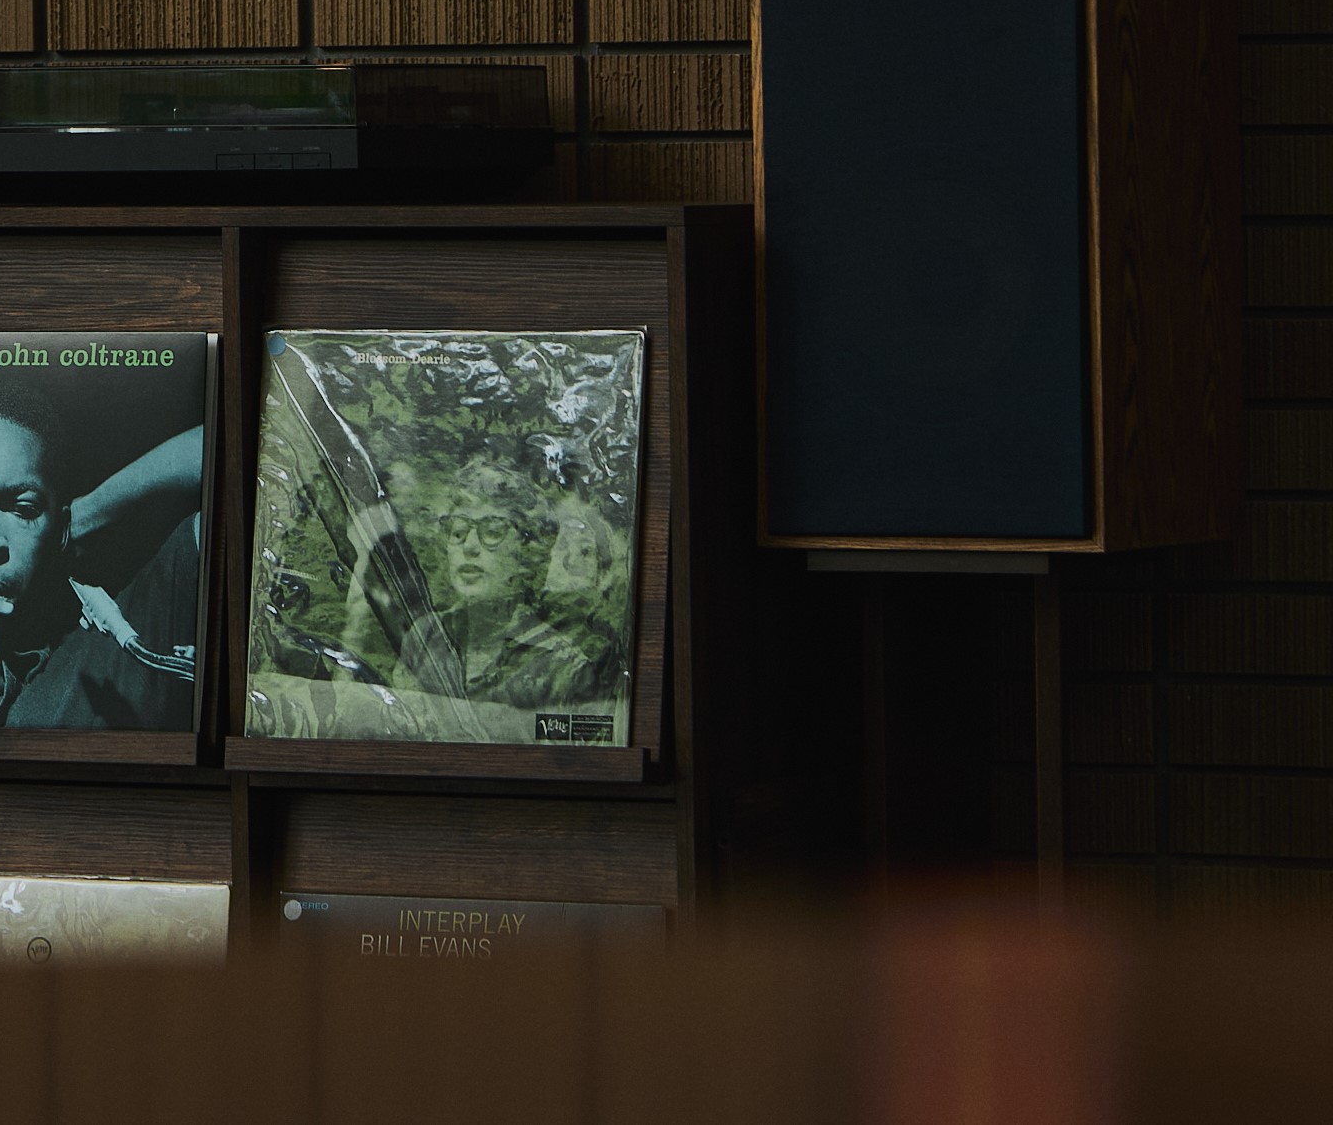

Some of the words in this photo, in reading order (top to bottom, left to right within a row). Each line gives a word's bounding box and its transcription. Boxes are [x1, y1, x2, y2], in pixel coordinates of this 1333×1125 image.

[59, 343, 174, 367] coltrane
[300, 901, 329, 911] EREO
[400, 910, 526, 934] INTERPLAY
[360, 934, 411, 957] BILL
[419, 936, 492, 959] EVANS
